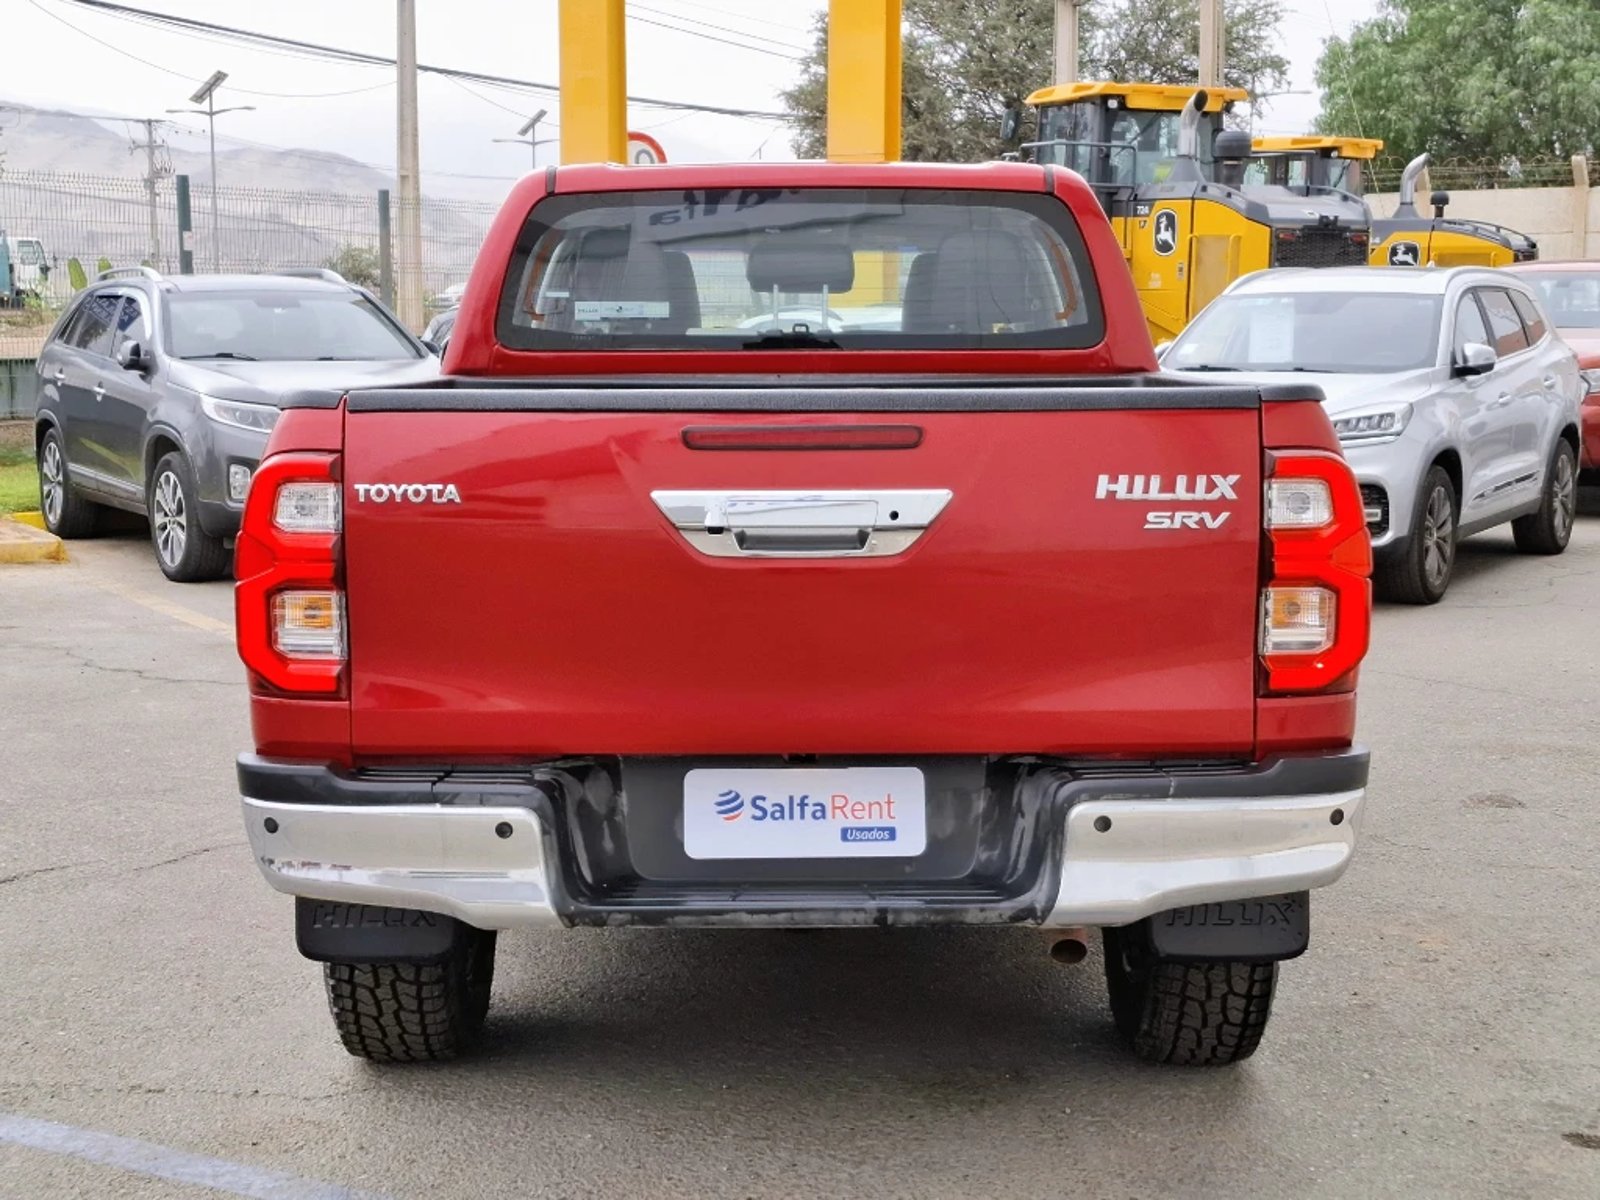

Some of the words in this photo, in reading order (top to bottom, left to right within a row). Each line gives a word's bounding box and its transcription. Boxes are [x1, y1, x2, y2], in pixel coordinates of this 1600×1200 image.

[353, 483, 462, 504] TOYOTA
[1095, 474, 1242, 501] HILUX
[1143, 511, 1232, 530] SRV
[846, 827, 891, 841] Usados
[1166, 901, 1293, 927] HILUX
